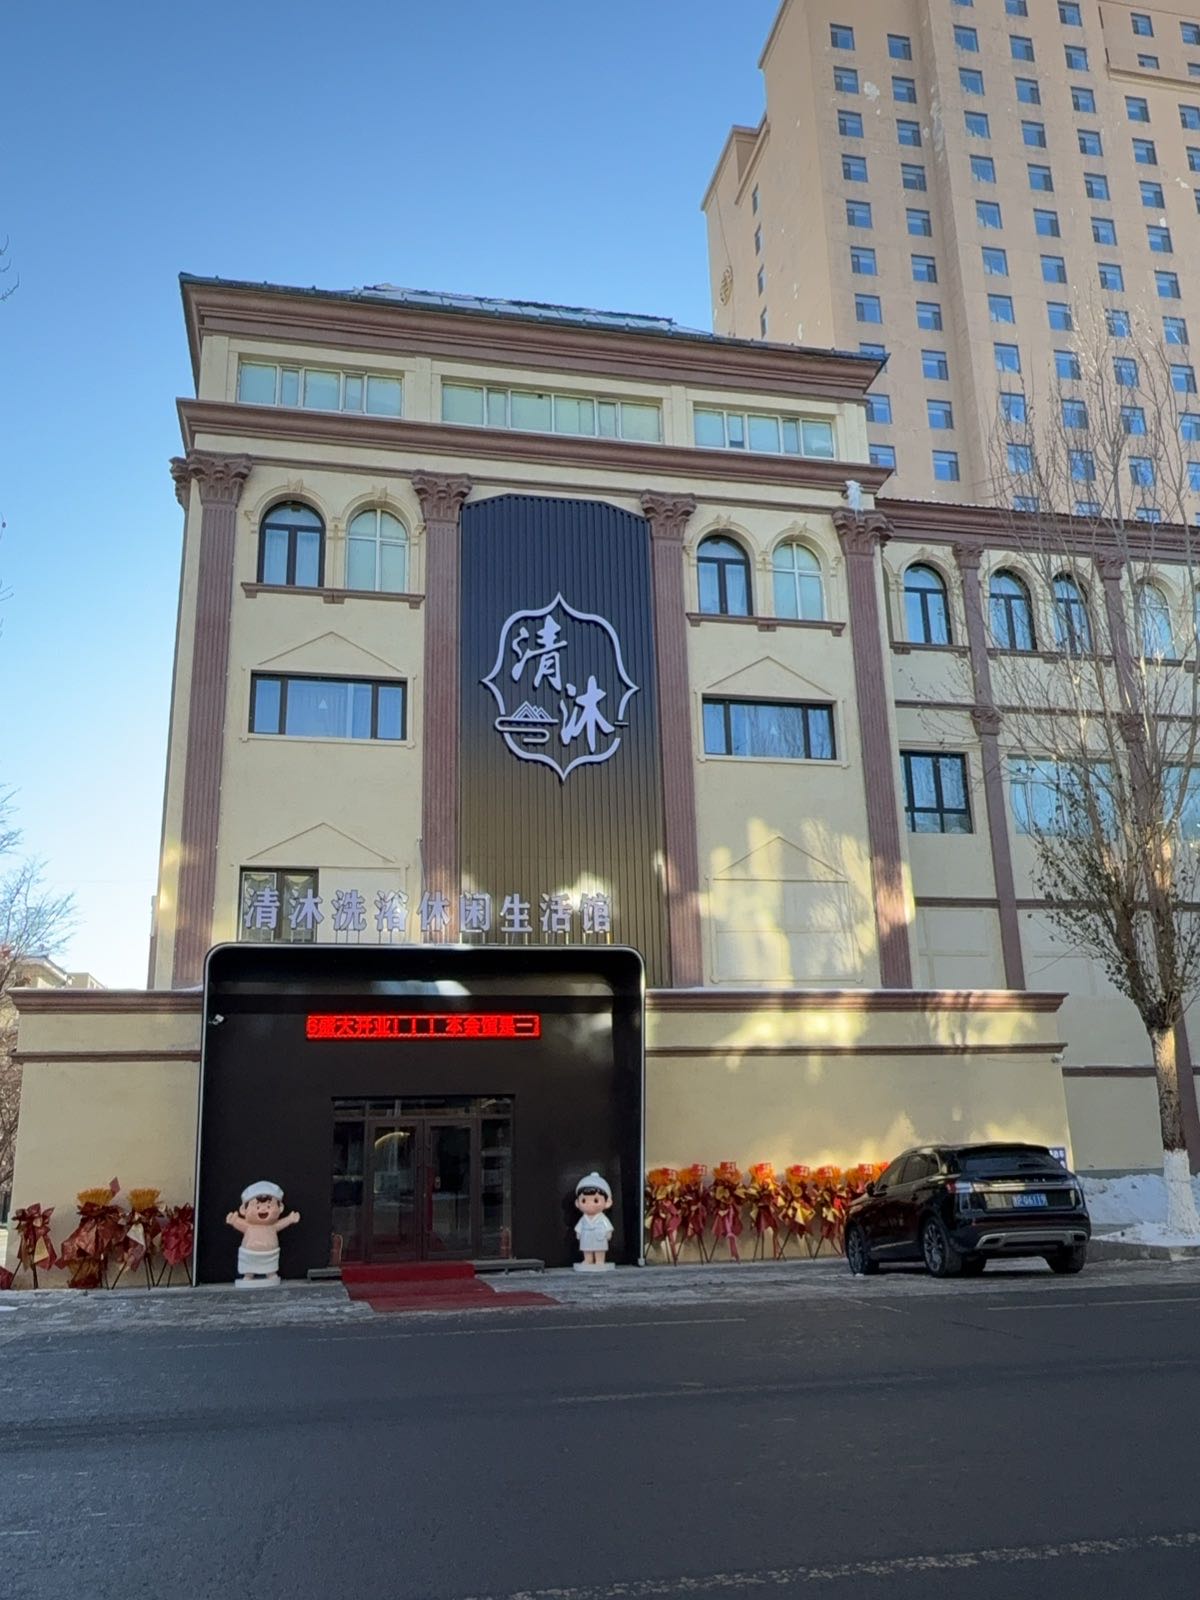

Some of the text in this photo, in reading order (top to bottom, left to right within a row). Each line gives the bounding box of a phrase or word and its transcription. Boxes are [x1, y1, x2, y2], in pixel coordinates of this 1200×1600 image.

[512, 614, 616, 753] 清沐
[244, 887, 611, 933] 清沐洗浴休闲生活馆
